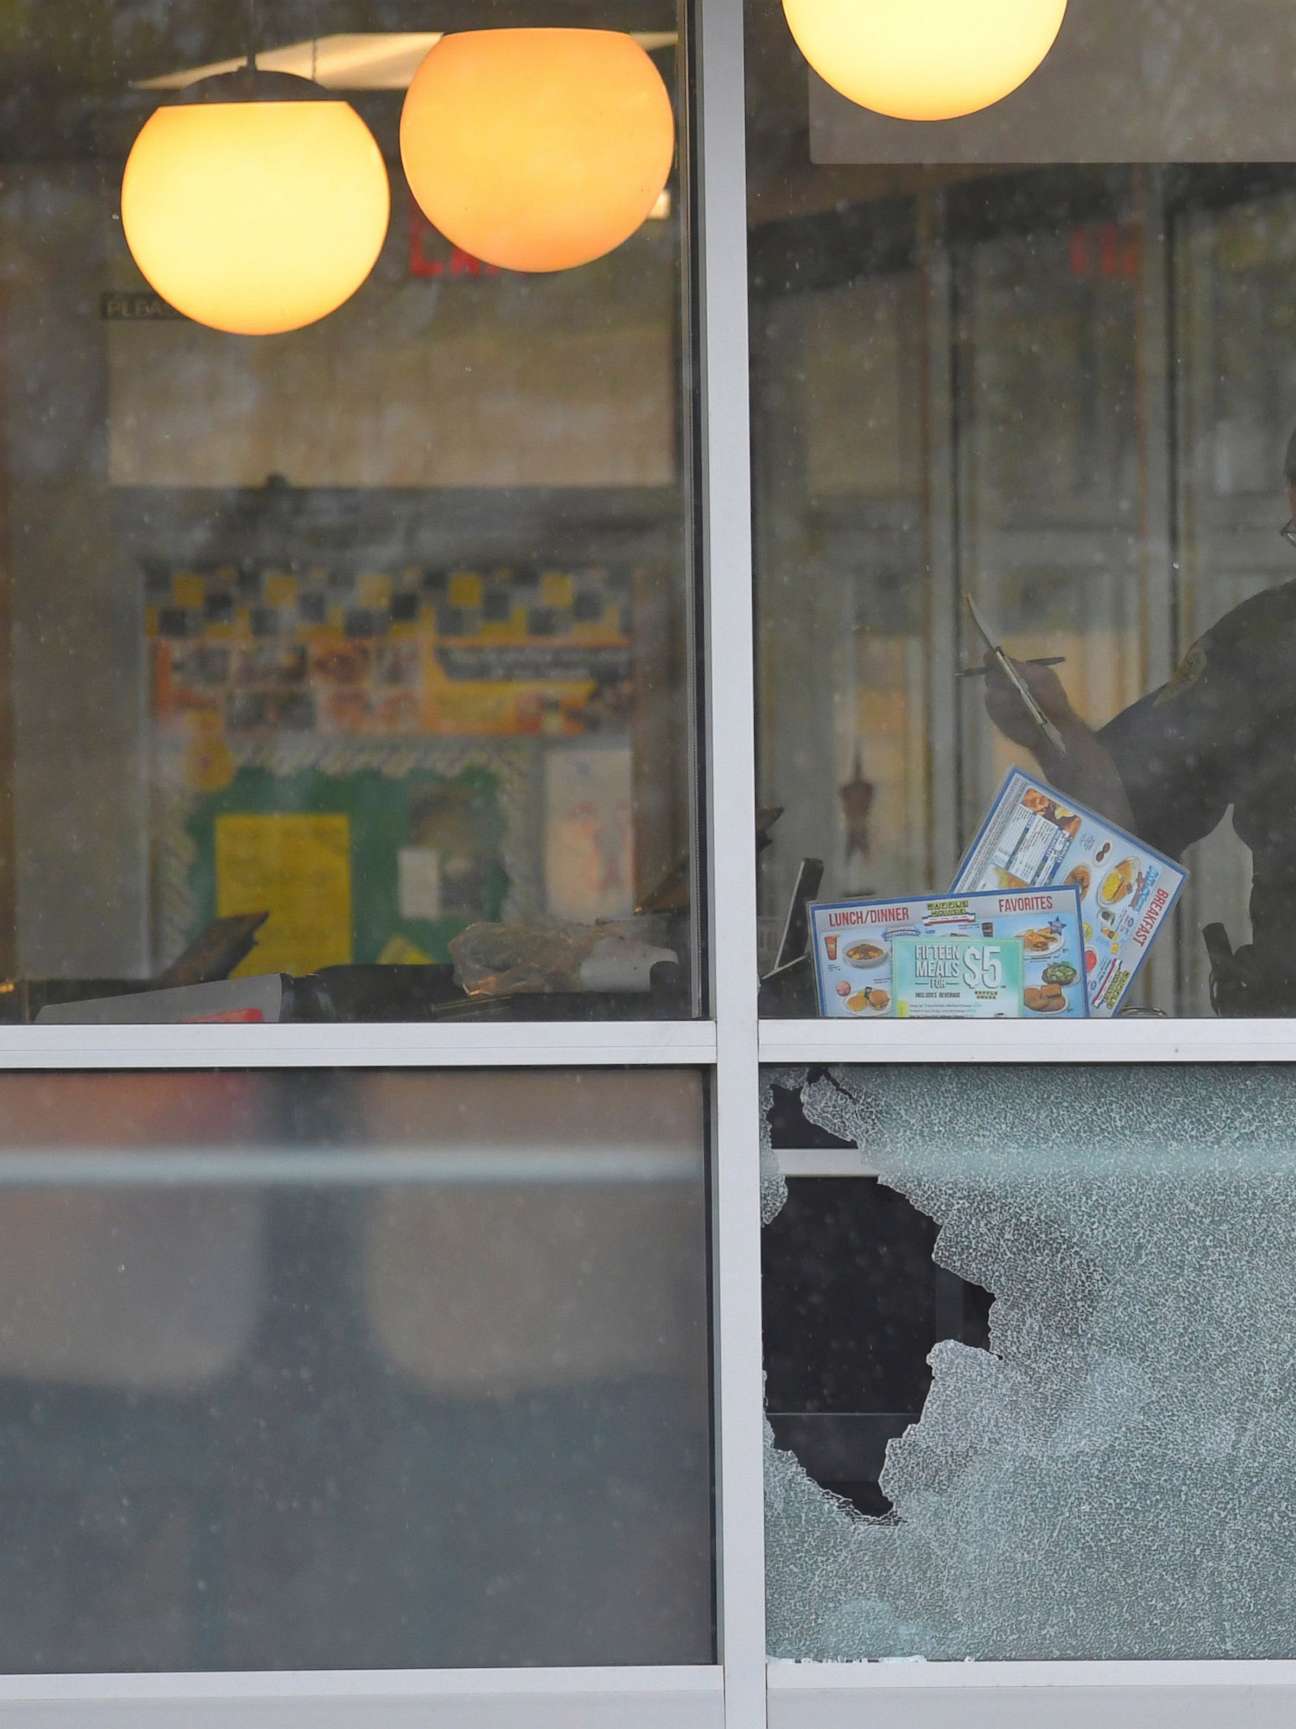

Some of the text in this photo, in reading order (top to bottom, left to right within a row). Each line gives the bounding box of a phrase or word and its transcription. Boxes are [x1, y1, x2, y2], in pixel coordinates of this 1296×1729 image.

[998, 896, 1053, 913] FAVORITES
[828, 907, 909, 927] LUNCH/DINNER
[1132, 887, 1170, 948] BREAKFAST
[915, 944, 960, 961] FIFTEEN
[915, 960, 960, 978] MEALS
[963, 945, 1003, 989] $5
